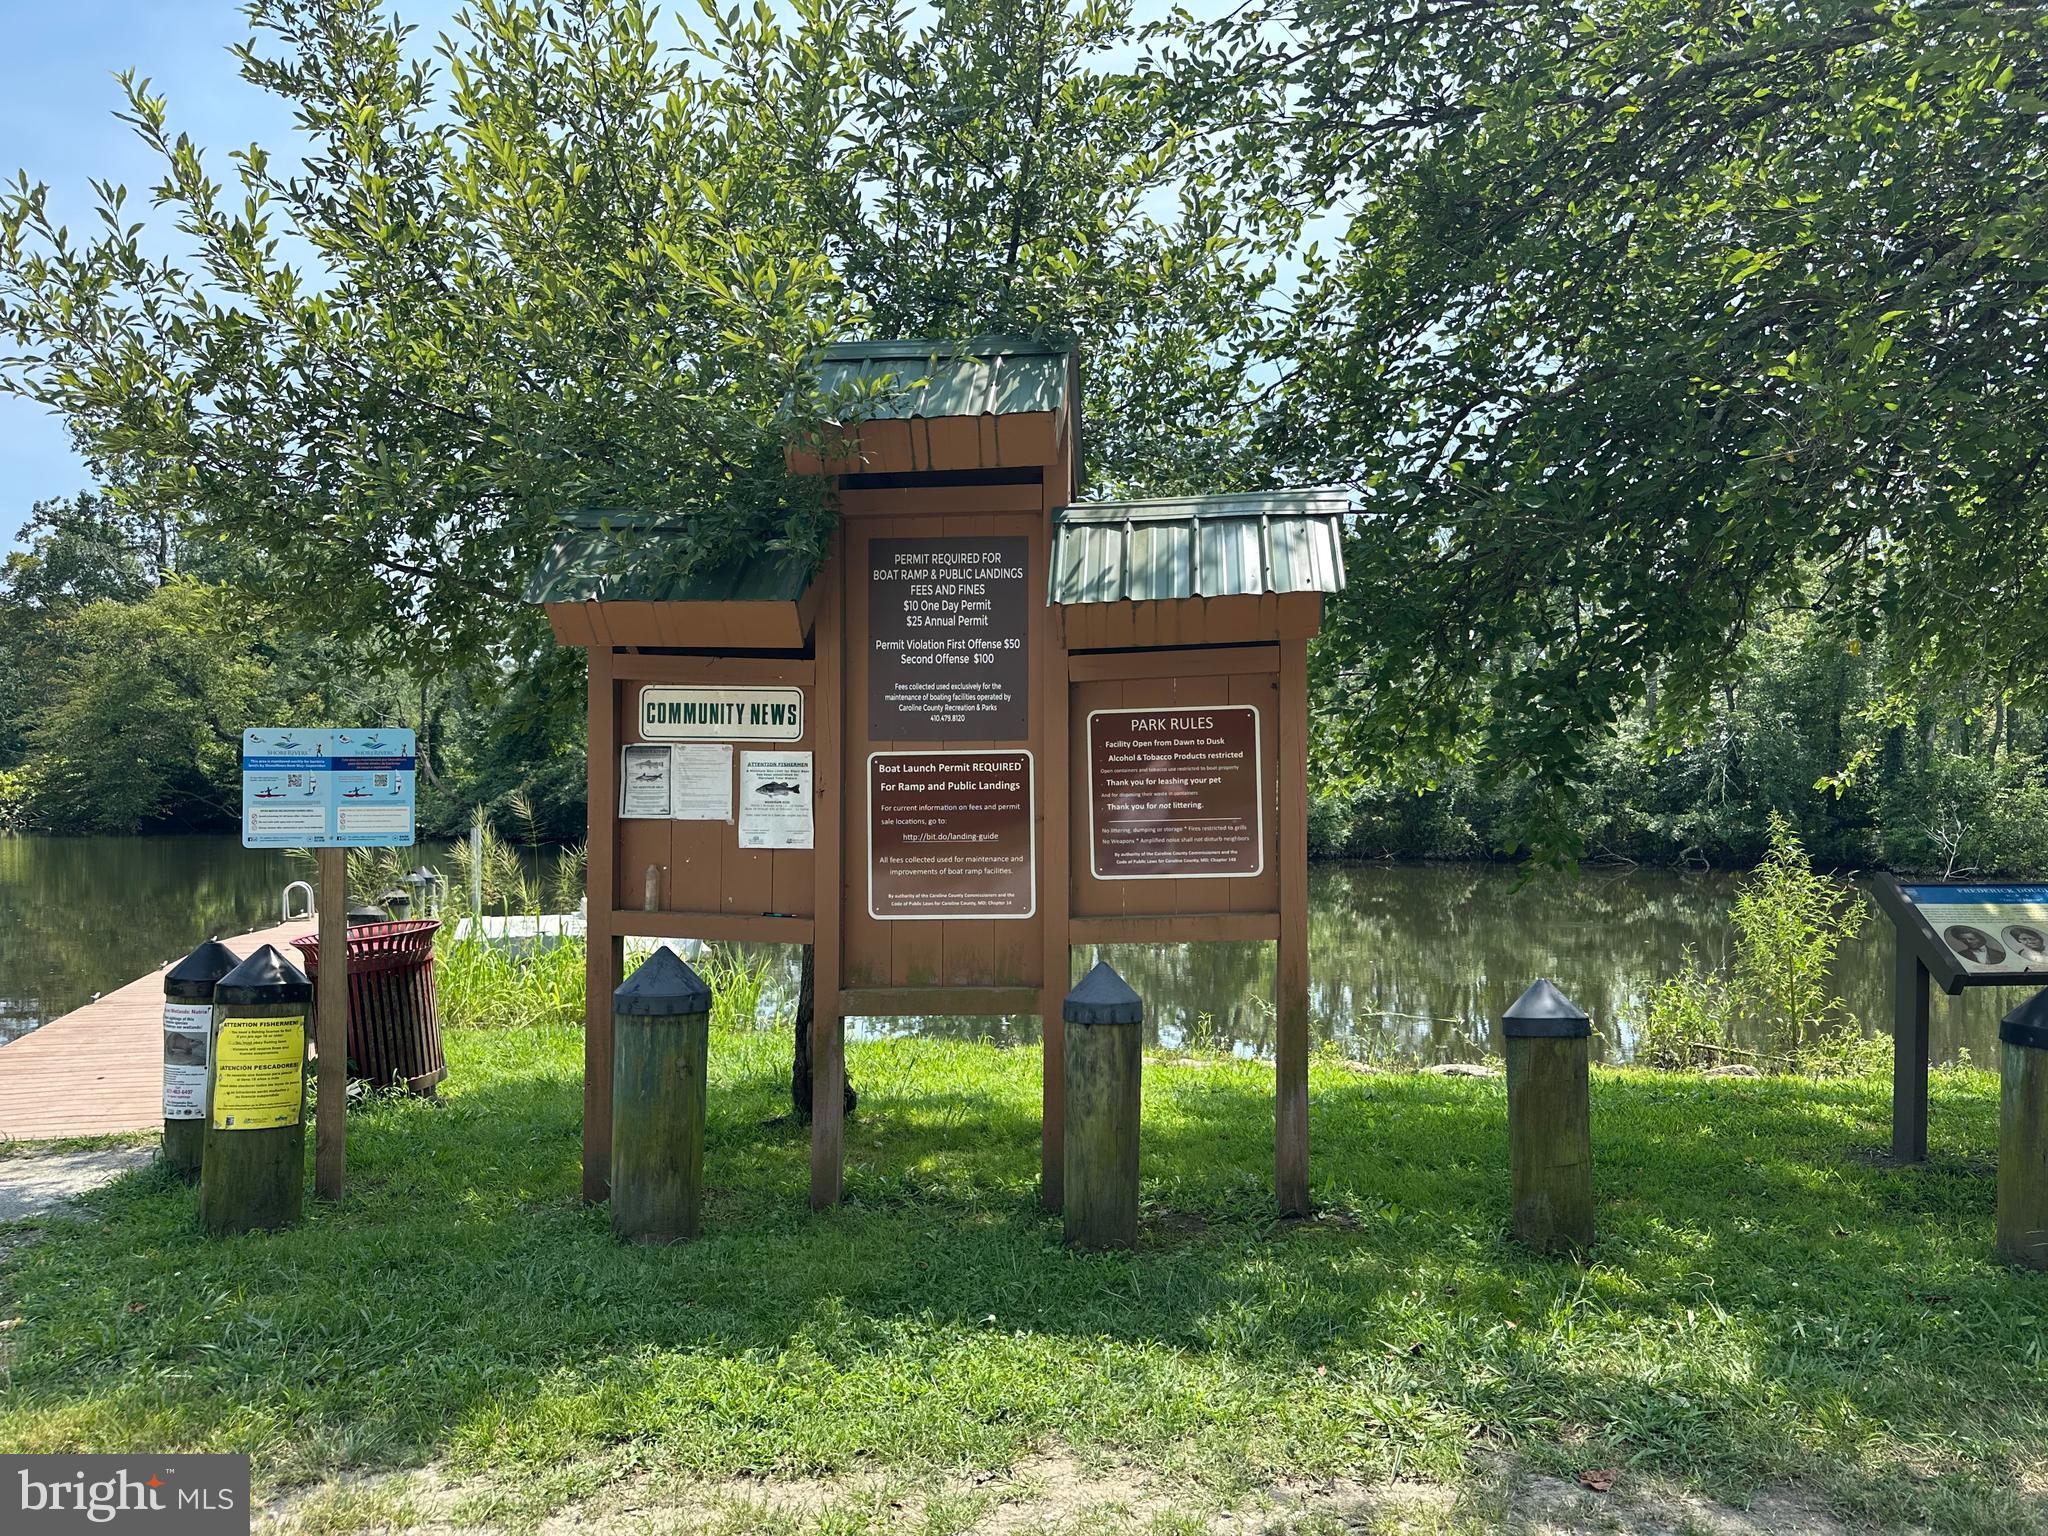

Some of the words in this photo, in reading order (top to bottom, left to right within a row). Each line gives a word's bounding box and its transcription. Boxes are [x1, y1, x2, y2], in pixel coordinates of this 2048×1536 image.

[895, 554, 929, 564] PERMIT
[932, 553, 980, 565] REQUIRED
[982, 553, 1001, 563] FOR
[874, 570, 898, 580] BOAT
[901, 569, 928, 580] RAMP
[930, 569, 937, 579] &
[939, 569, 972, 579] PUBLIC
[975, 568, 1023, 579] LANDINGS
[911, 585, 933, 595] FEES
[935, 585, 956, 595] AND
[958, 585, 985, 594] FINES
[904, 601, 919, 611] $10
[920, 601, 940, 611] One
[942, 600, 959, 613] Day
[961, 600, 991, 610] Permit
[906, 616, 922, 626] $25
[924, 616, 956, 626] Annual
[958, 616, 988, 626] Permit
[876, 640, 904, 650] Permit
[906, 639, 945, 649] Violation
[947, 639, 966, 649] First
[967, 639, 1002, 649] Offense
[1004, 639, 1020, 649] $50
[901, 654, 933, 664] Second
[935, 654, 969, 664] Offense
[974, 654, 994, 664] $100
[951, 683, 981, 691] exclusively
[929, 694, 952, 702] boating
[1003, 693, 1011, 702] by
[923, 704, 944, 712] County
[647, 703, 744, 724] COMMUNITY
[750, 704, 797, 725] NEWS
[1131, 718, 1166, 731] PARK
[1170, 717, 1213, 730] RULES
[1106, 741, 1131, 749] Facility
[1132, 740, 1152, 748] Open
[879, 764, 900, 772] Boat
[903, 764, 936, 772] Launch
[938, 763, 970, 772] Permit
[972, 762, 1022, 772] REQUIRED
[898, 782, 925, 792] Ramp
[928, 782, 945, 790] and
[948, 782, 976, 790] Public
[979, 781, 1020, 791] Landings
[1158, 778, 1188, 786] leashing
